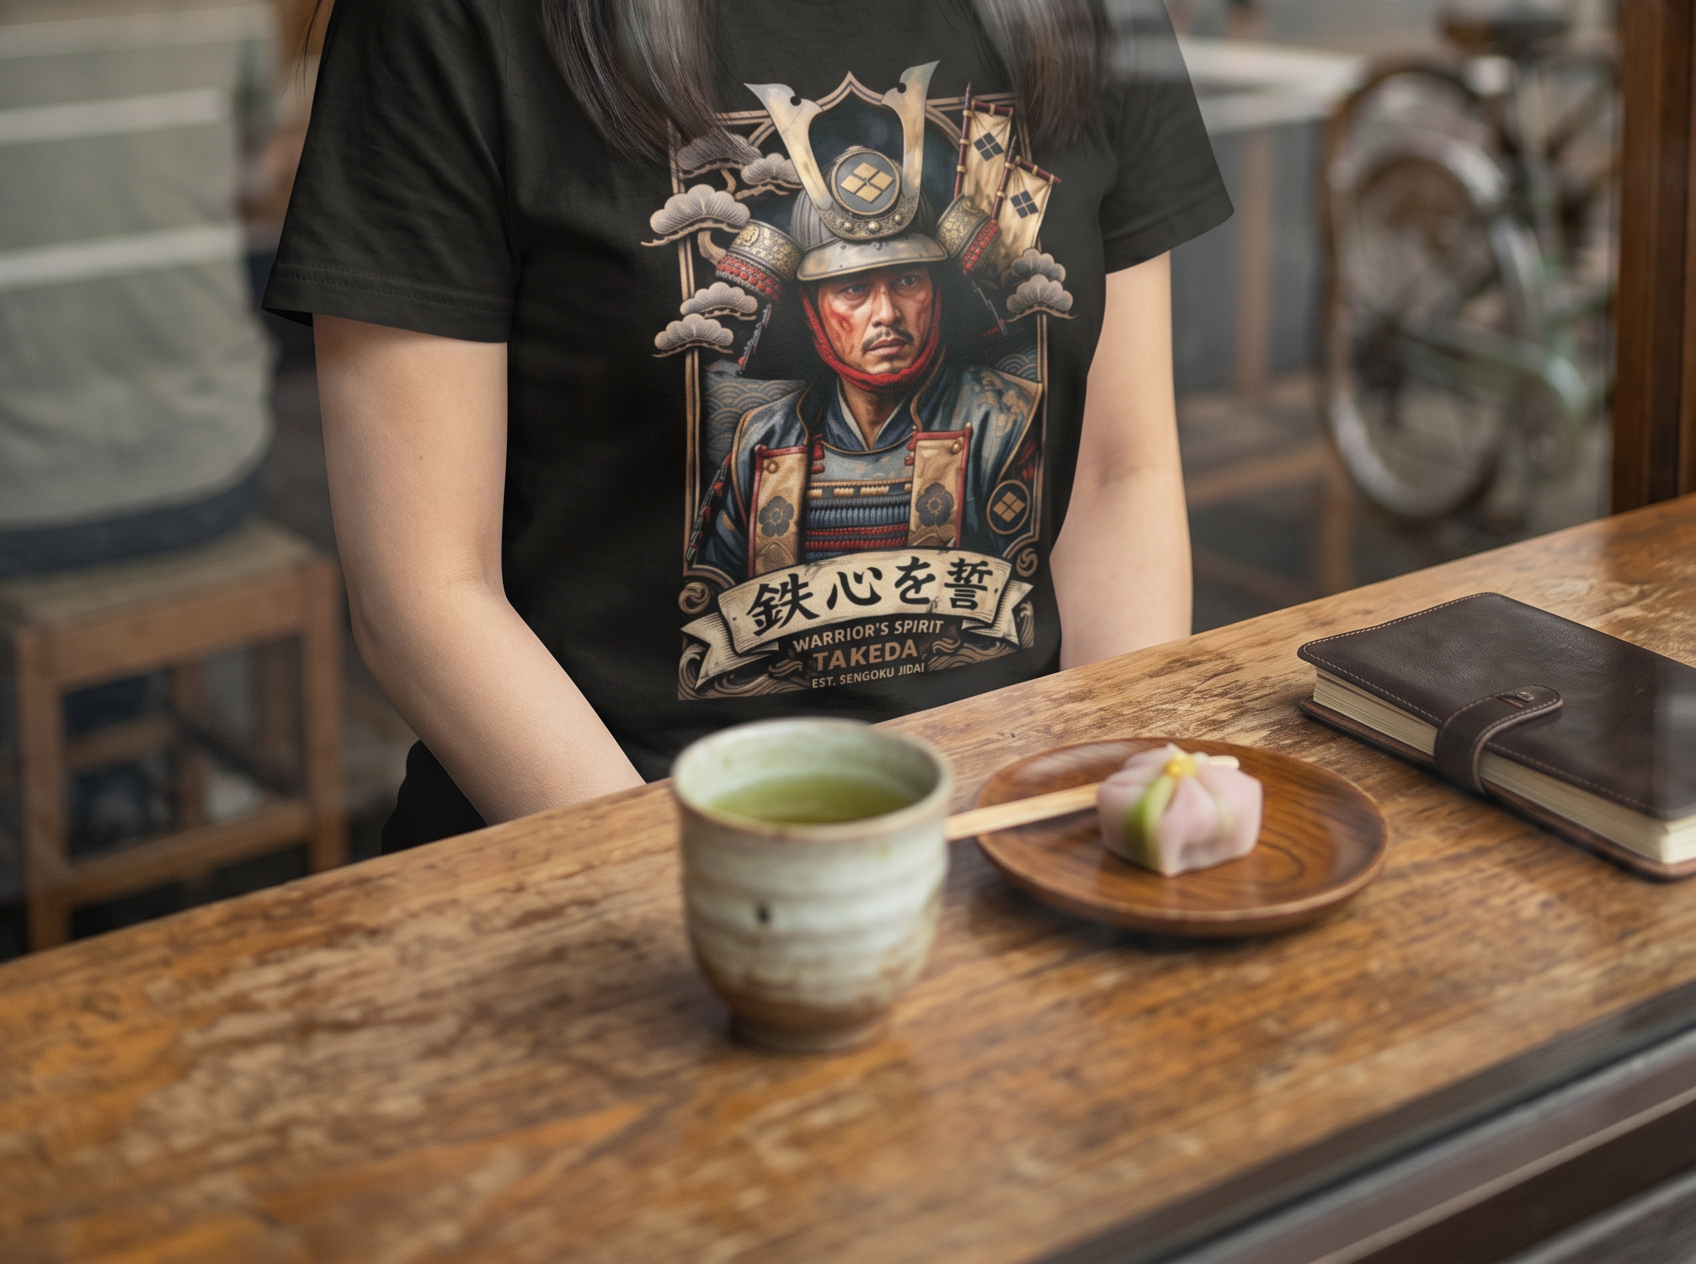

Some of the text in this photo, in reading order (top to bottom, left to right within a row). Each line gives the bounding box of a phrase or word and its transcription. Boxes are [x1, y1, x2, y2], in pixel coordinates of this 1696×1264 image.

[745, 556, 994, 637] 鉄心を誓
[792, 619, 945, 654] WARRIOR'S SPIRIT
[812, 639, 919, 672] TAKEDA
[811, 662, 925, 689] EST. SENGOKU JIDAI
